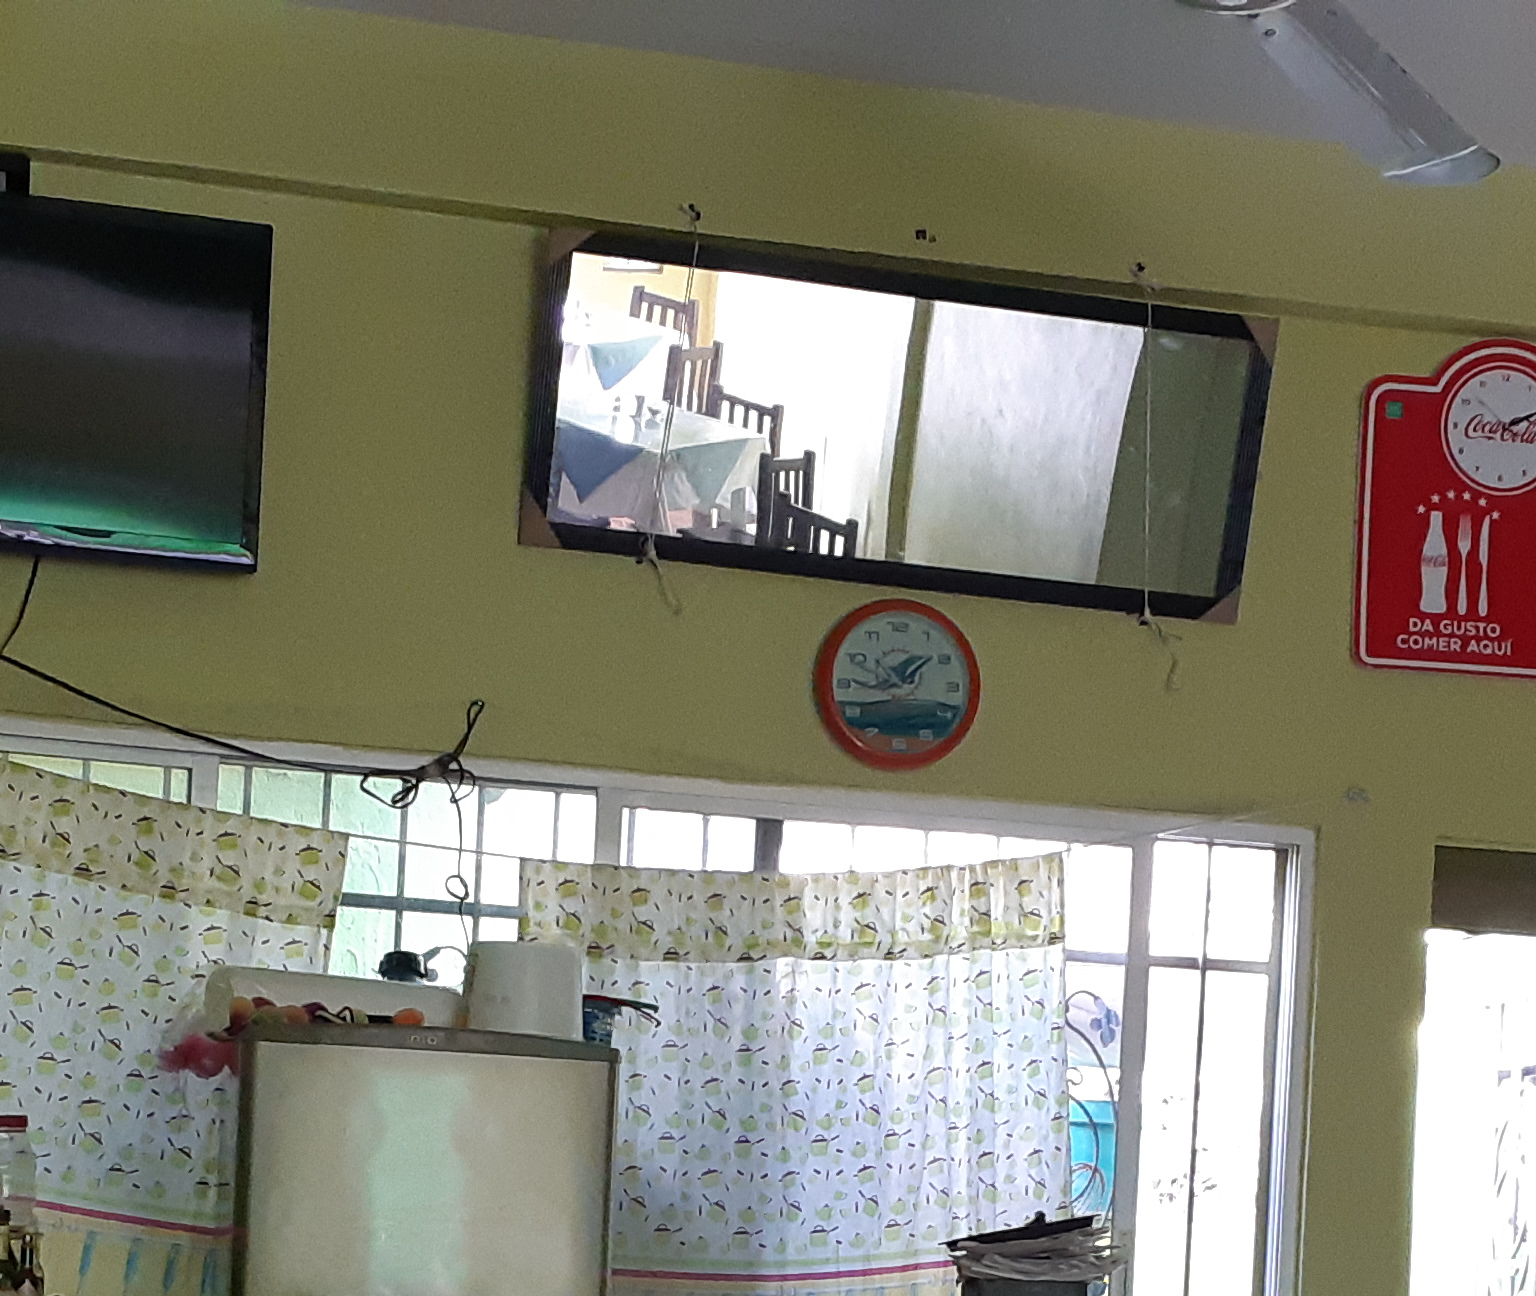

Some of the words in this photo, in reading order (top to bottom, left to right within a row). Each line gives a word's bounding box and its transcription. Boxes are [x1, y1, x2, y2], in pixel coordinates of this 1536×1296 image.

[1409, 617, 1434, 632] DA
[1439, 620, 1501, 638] GUSTO
[1396, 634, 1462, 652] COMER
[1467, 638, 1514, 656] AQUÍ
